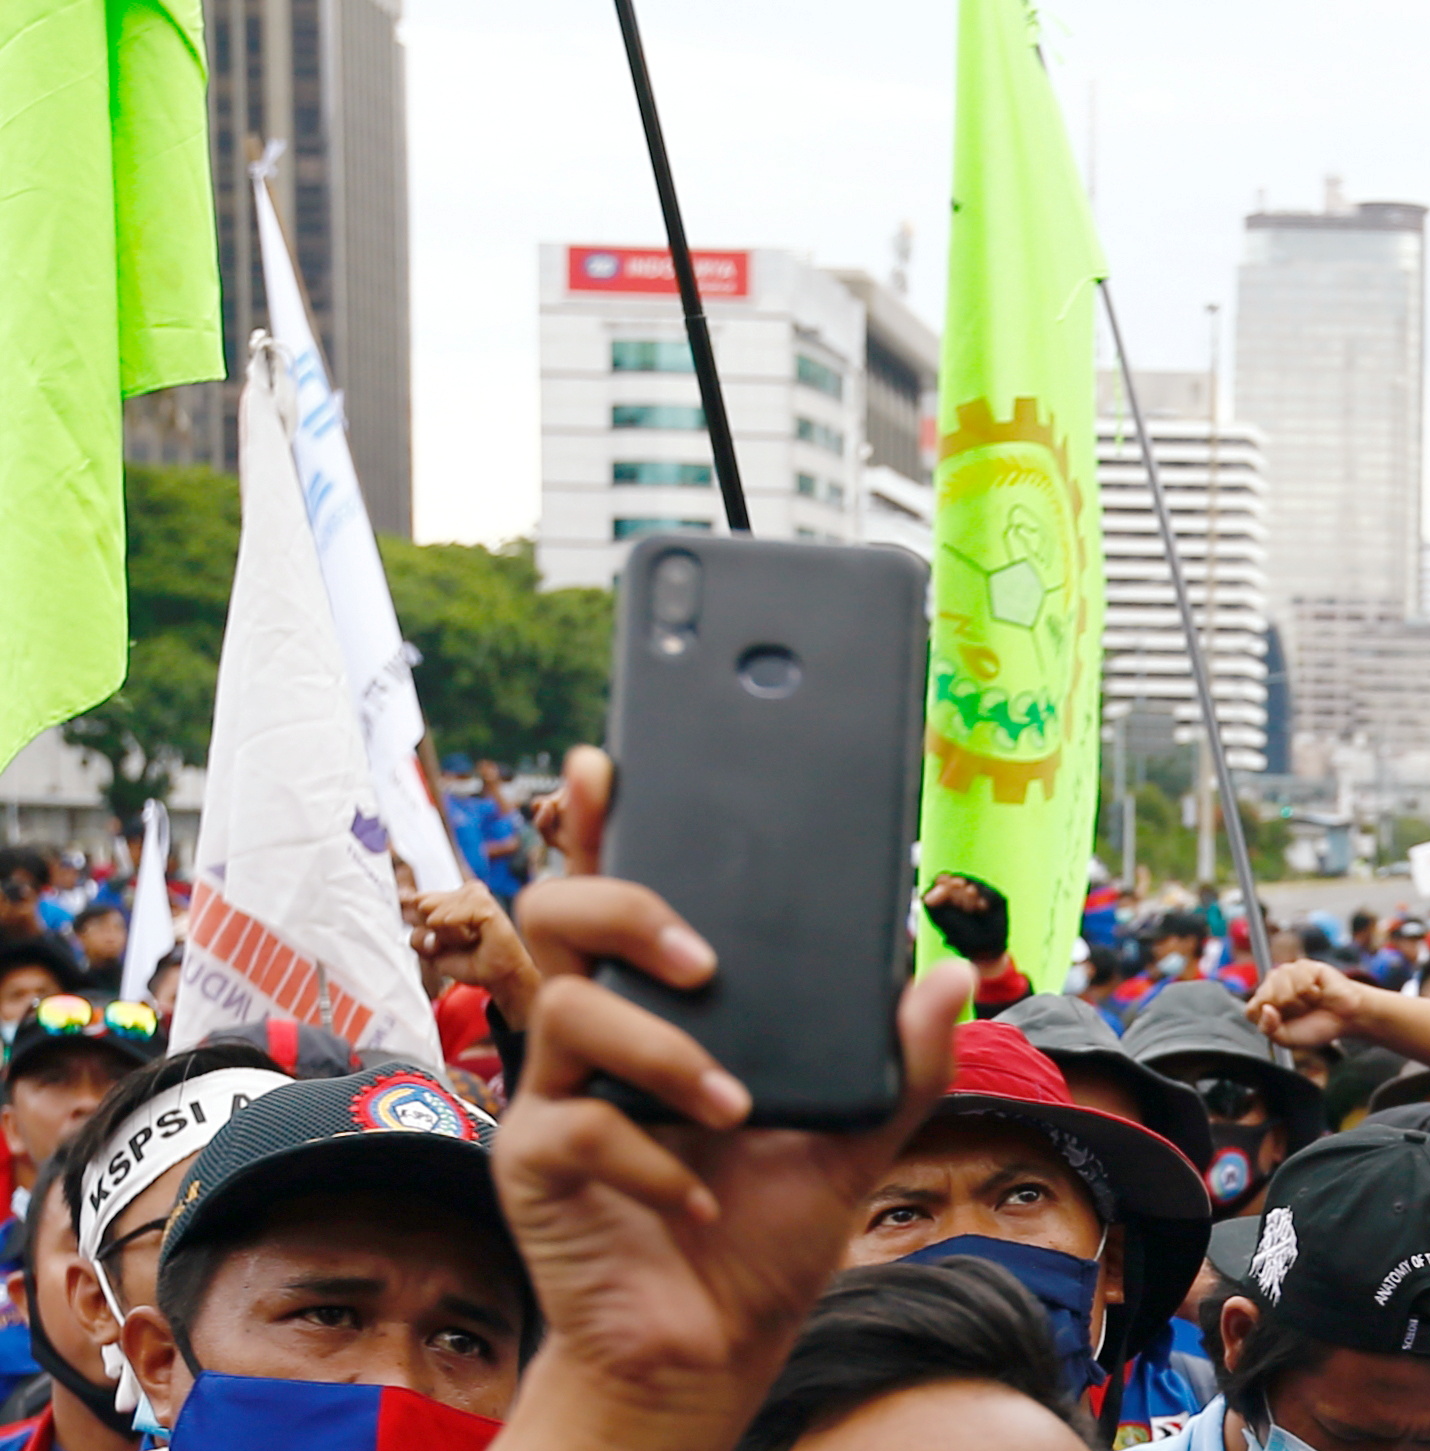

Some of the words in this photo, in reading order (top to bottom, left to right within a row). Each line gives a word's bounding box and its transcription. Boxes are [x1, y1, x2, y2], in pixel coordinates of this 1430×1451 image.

[90, 1101, 206, 1213] KSPSI
[1374, 1260, 1412, 1307] ANATOMY
[1411, 1253, 1425, 1268] OF
